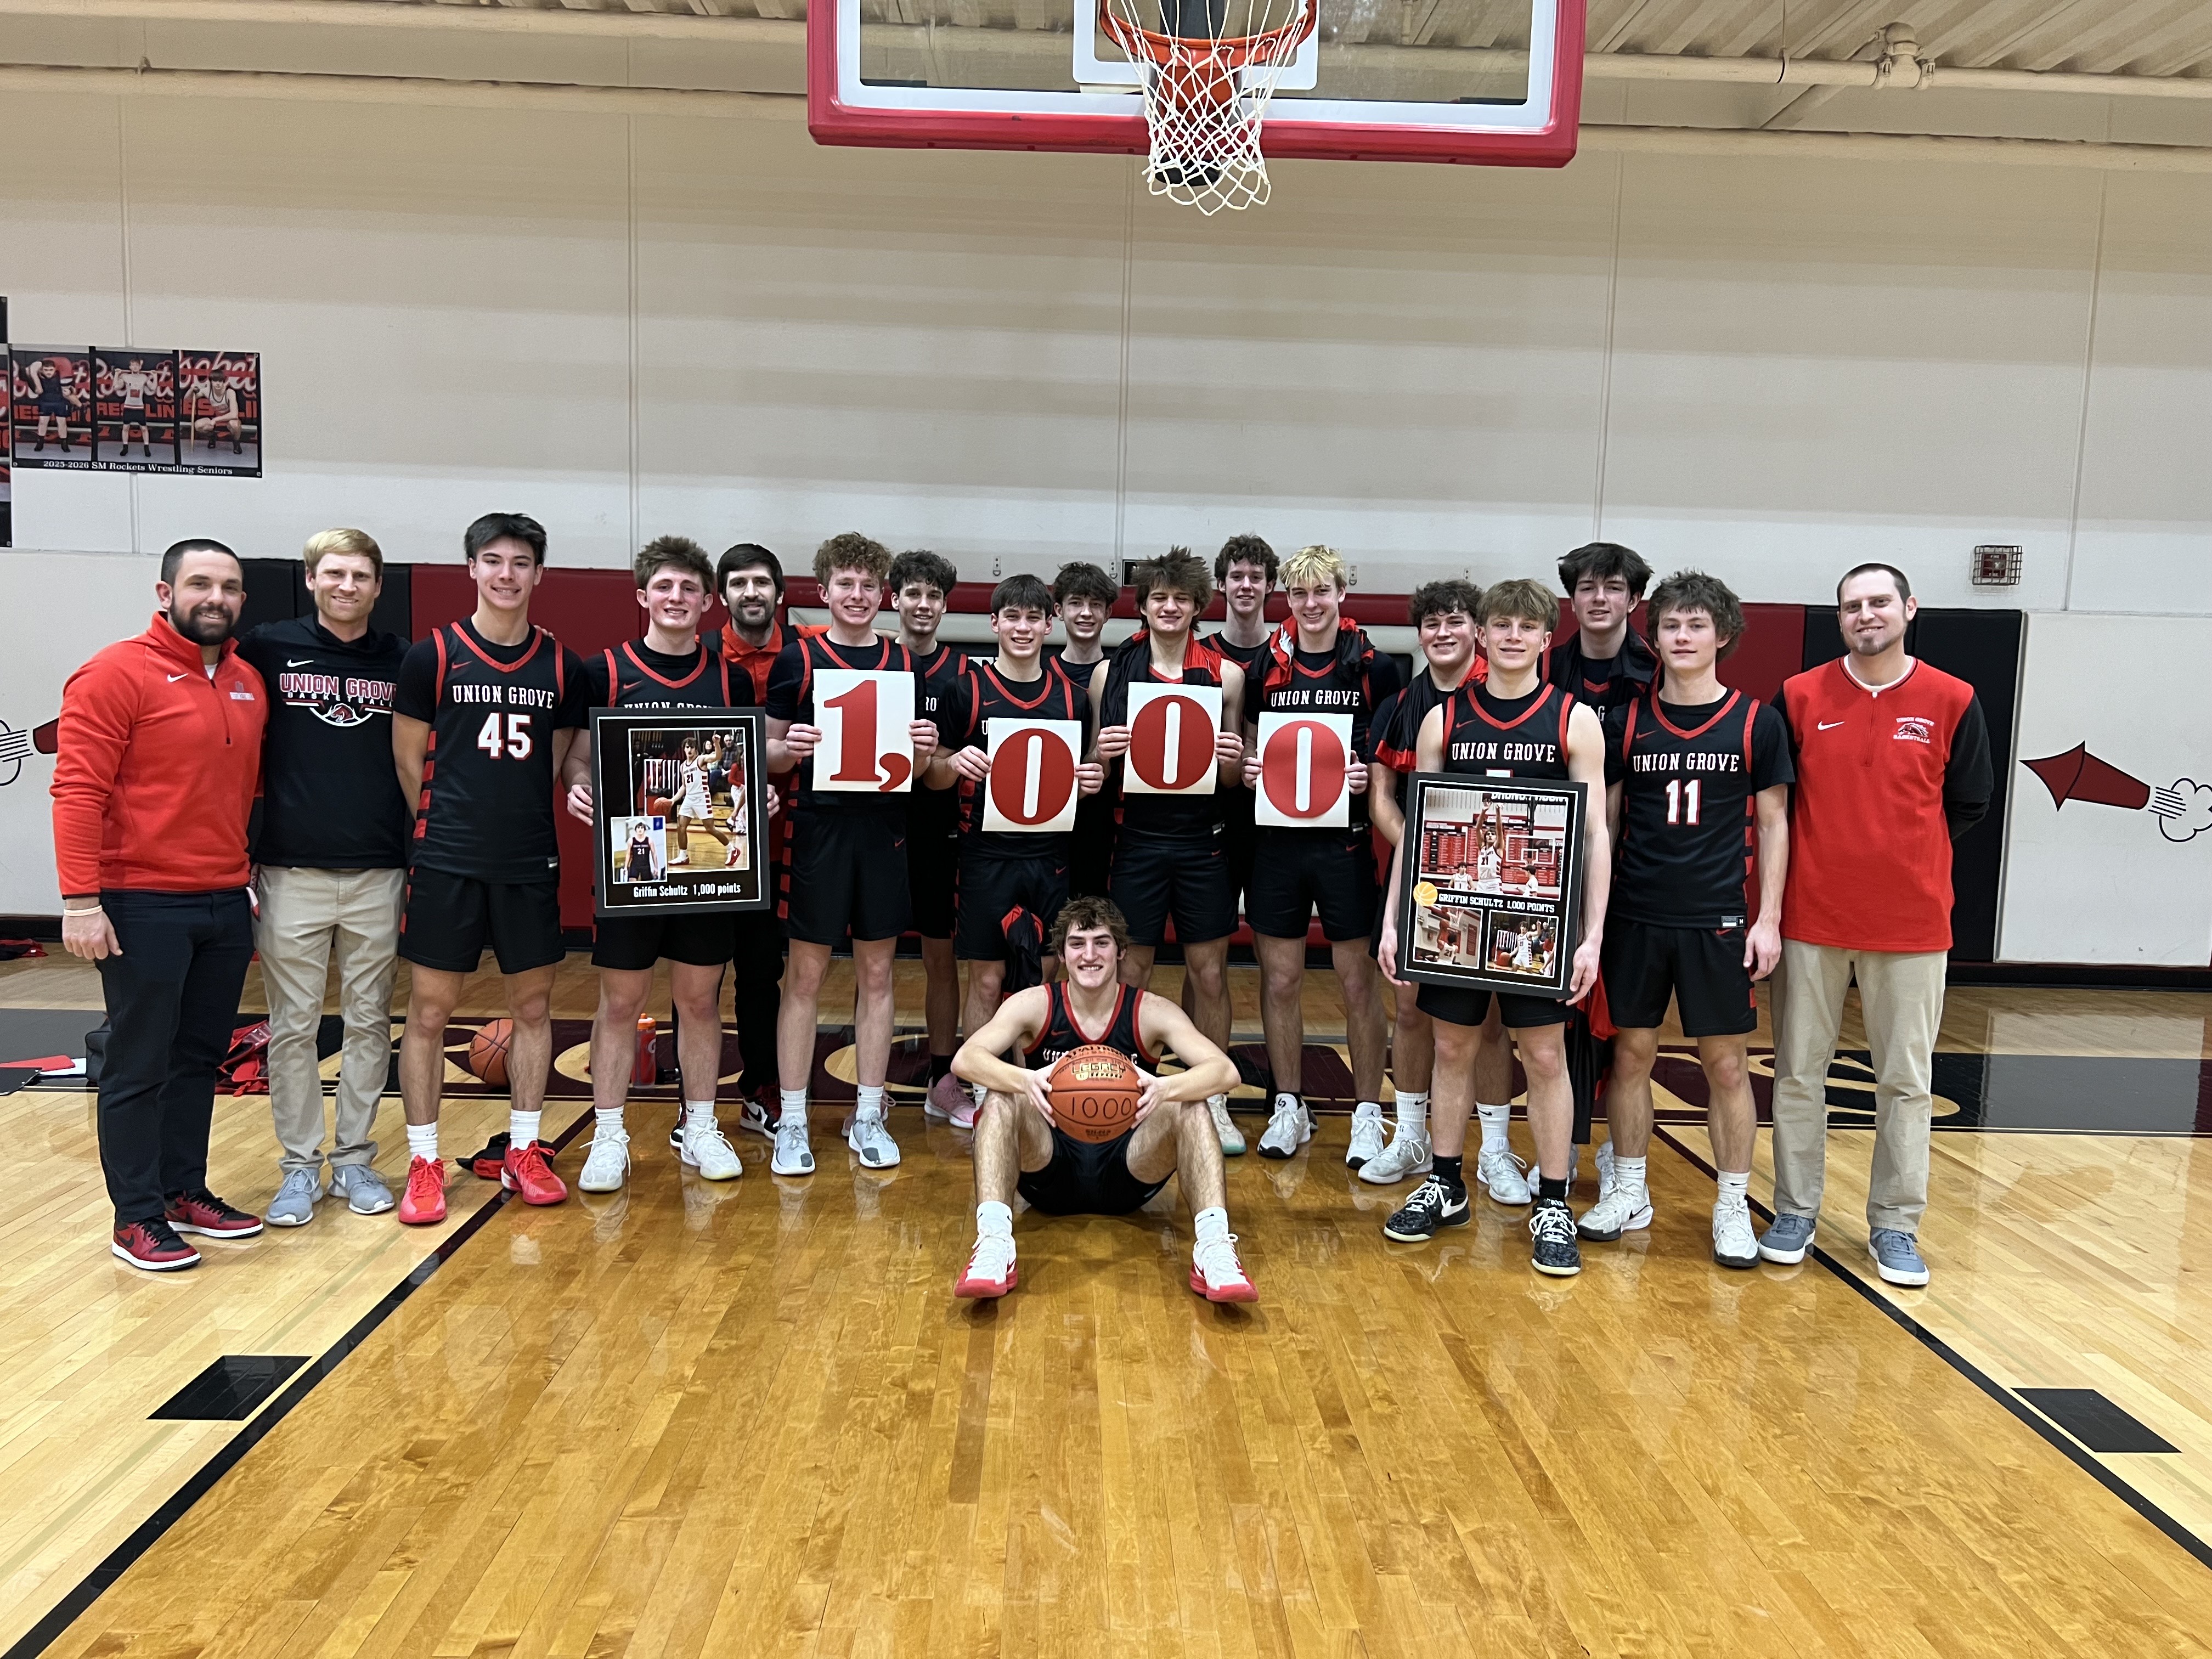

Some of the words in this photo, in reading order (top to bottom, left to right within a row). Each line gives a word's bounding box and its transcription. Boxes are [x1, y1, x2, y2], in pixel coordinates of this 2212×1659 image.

[92, 461, 106, 470] SM
[110, 462, 145, 471] Rockets
[148, 464, 194, 474] Wrestling
[197, 466, 233, 475] Seniors
[280, 673, 339, 695] UNION
[452, 685, 502, 703] UNION
[508, 686, 554, 709] GROVE
[1271, 690, 1311, 707] UNION
[1315, 690, 1360, 707] GROVE
[477, 712, 533, 760] 45
[1130, 695, 1215, 790] 0
[1452, 742, 1498, 760] UNION
[1503, 743, 1556, 763] GROVE
[1633, 753, 1681, 772] UNION
[1686, 753, 1740, 772] GROVE
[686, 773, 693, 783] 21
[990, 728, 1074, 825] 0
[1262, 720, 1346, 818] 0
[1665, 778, 1701, 826] 11
[633, 886, 657, 898] Griffin
[659, 885, 688, 896] Schultz
[693, 883, 715, 896] 1,000
[718, 883, 741, 896] points
[1438, 893, 1468, 904] GRIFFIN
[1469, 896, 1504, 907] SCHULTZ
[1527, 902, 1555, 913] POINTS
[1072, 1097, 1132, 1119] 1000
